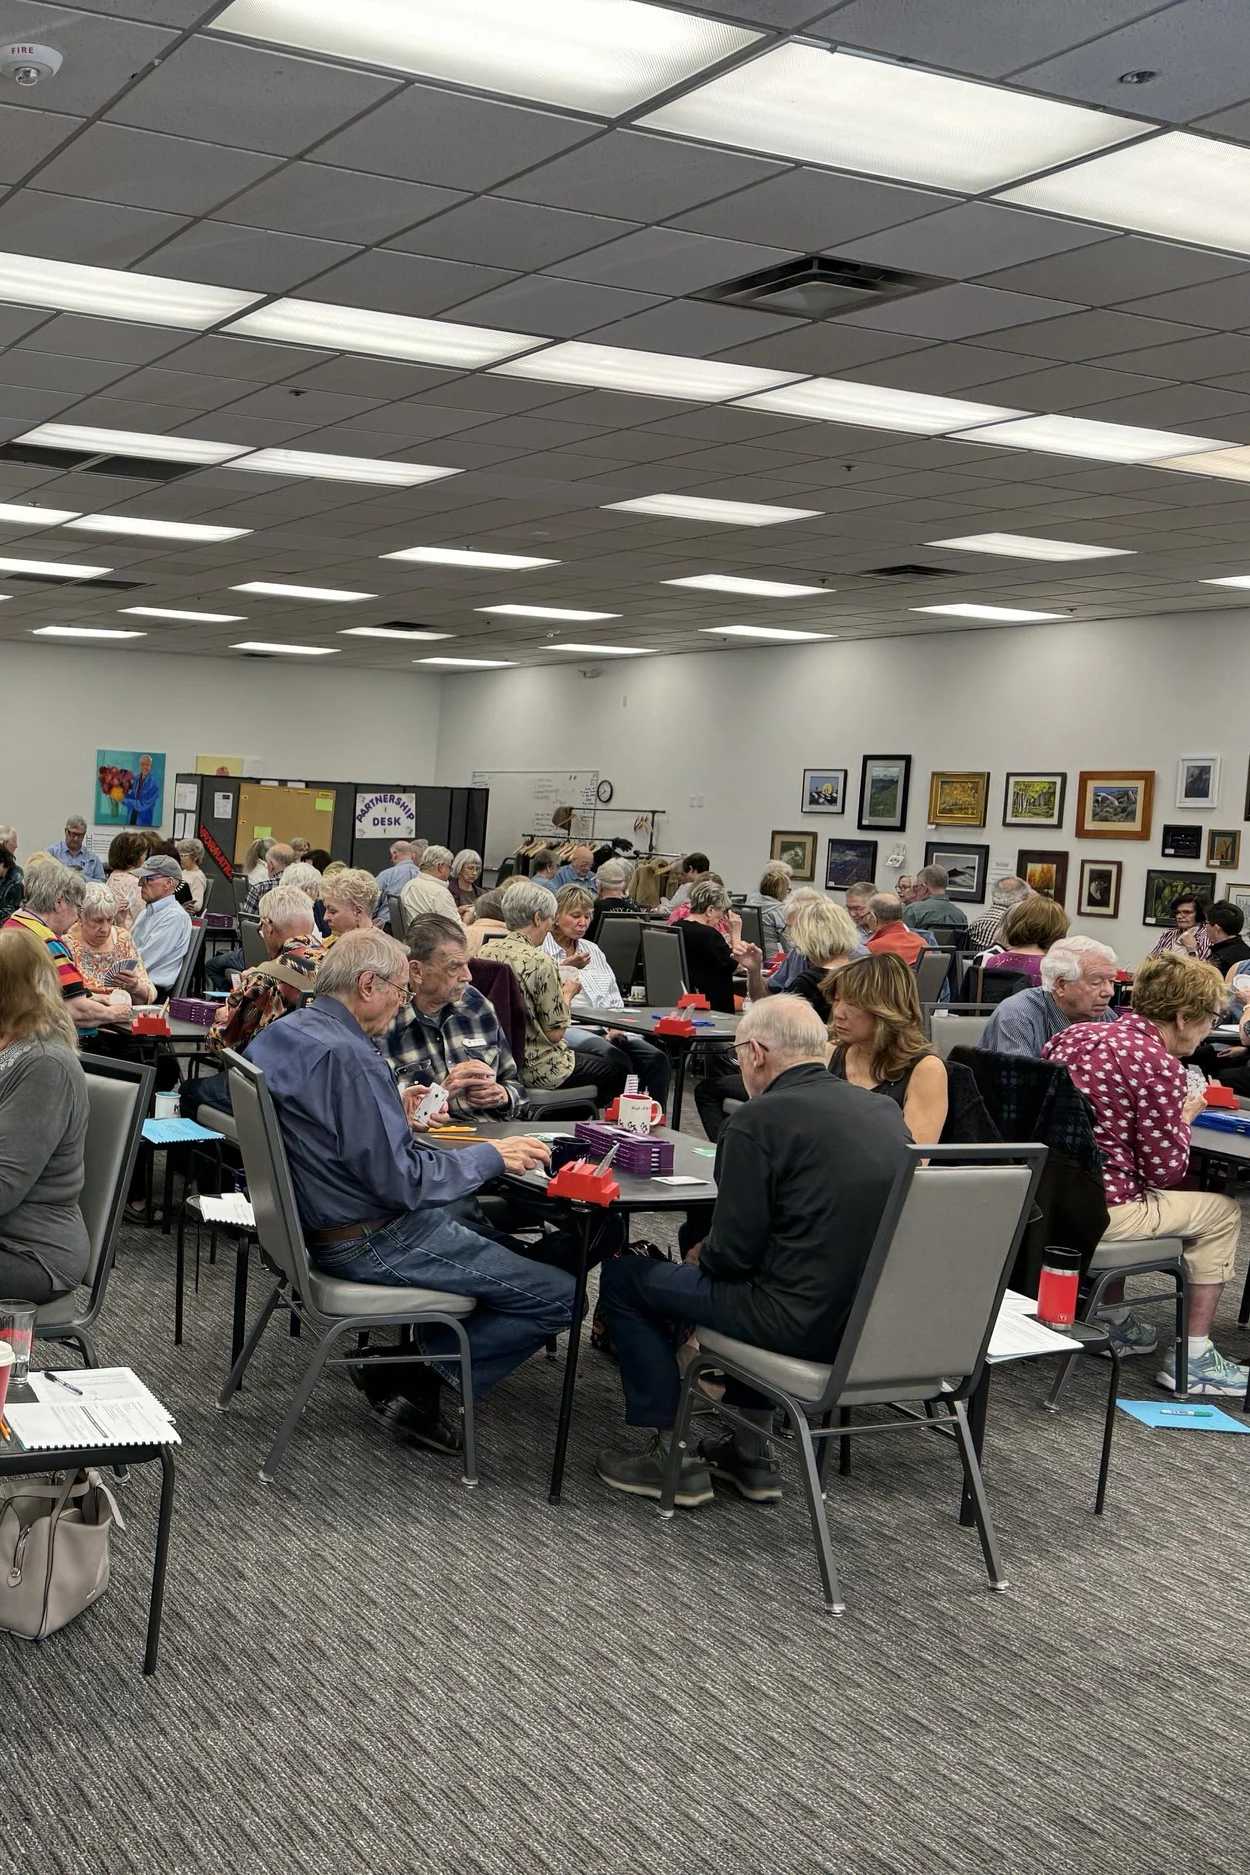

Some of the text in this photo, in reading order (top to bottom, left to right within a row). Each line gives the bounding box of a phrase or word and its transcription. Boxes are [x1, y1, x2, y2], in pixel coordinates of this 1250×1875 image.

[11, 46, 34, 55] FIRE
[356, 794, 415, 823] PARTNERSHIP
[373, 817, 401, 827] DESK
